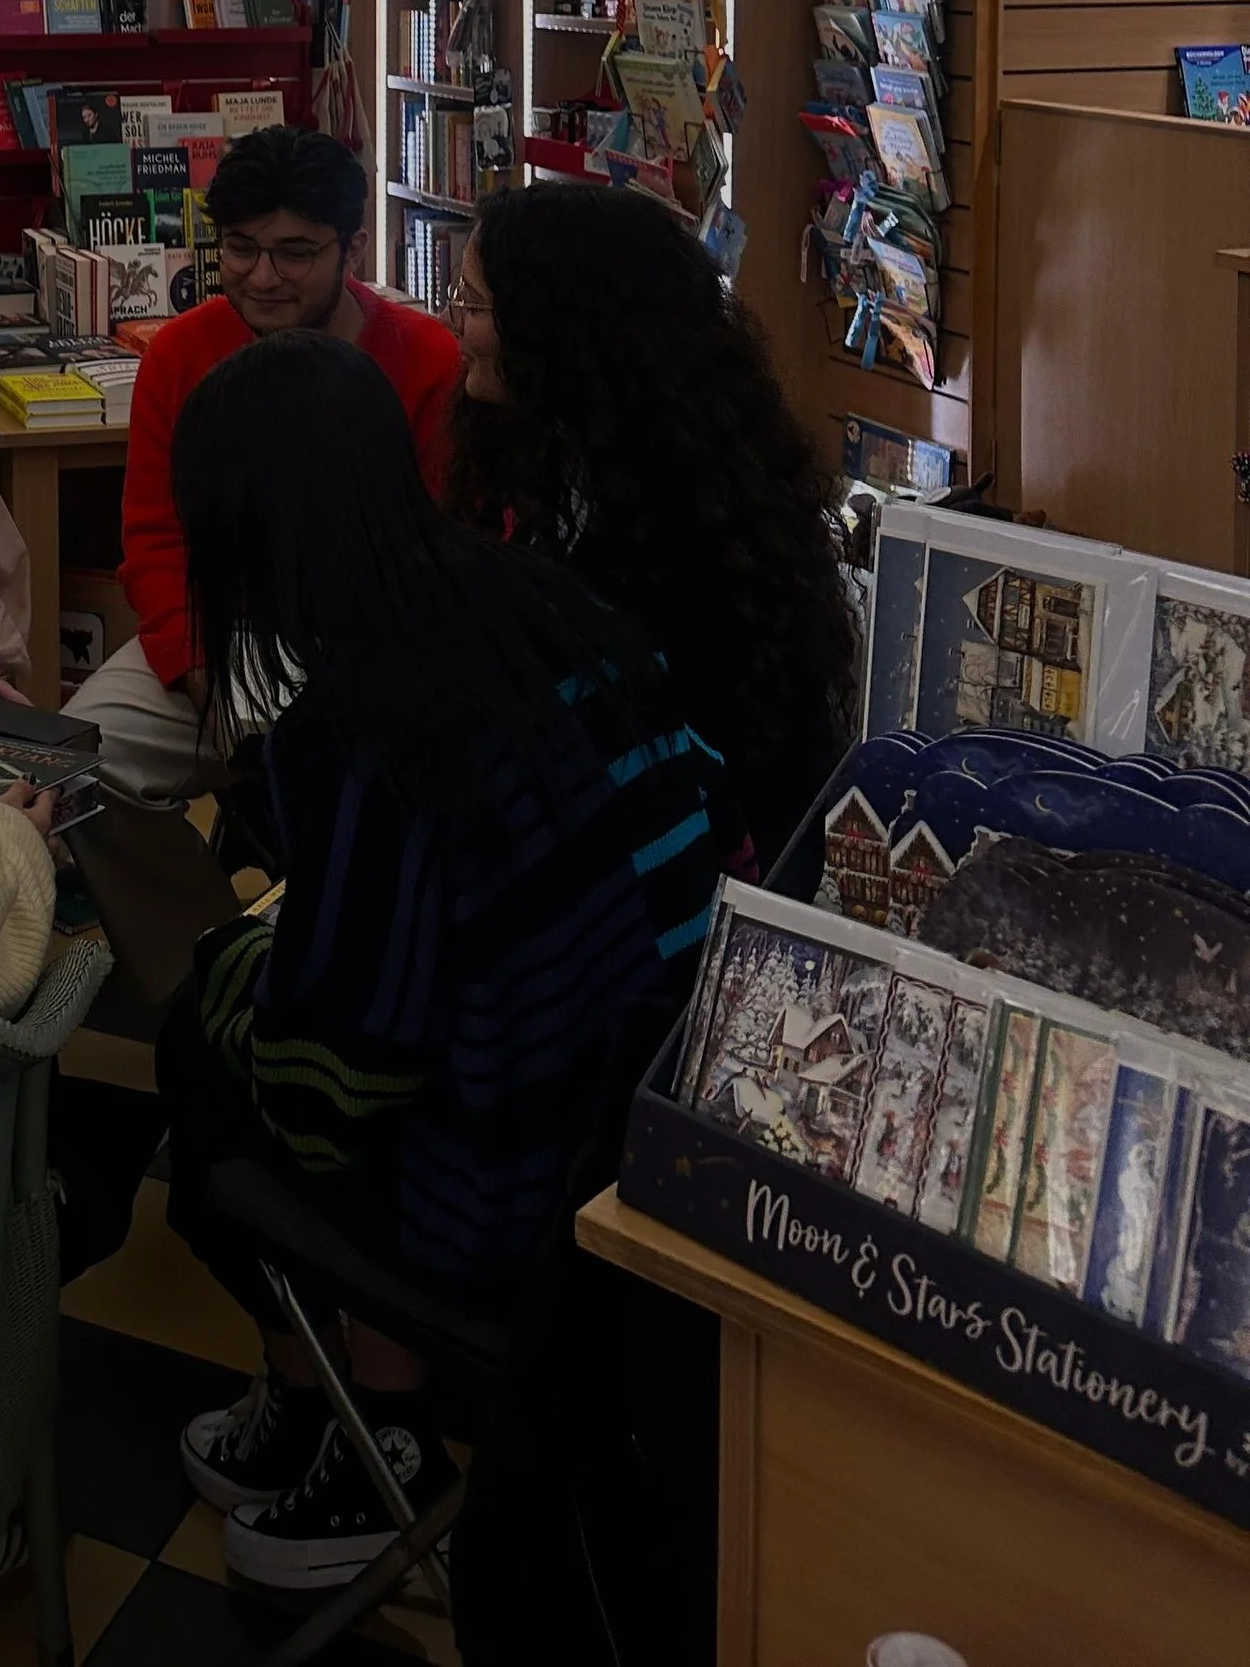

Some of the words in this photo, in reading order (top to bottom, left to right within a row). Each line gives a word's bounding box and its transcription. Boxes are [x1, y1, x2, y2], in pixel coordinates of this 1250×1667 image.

[119, 11, 136, 23] der
[225, 97, 249, 105] MAJA
[250, 96, 277, 104] LUNDE
[122, 111, 141, 123] WER
[126, 124, 145, 137] SOL
[142, 153, 180, 163] MICHEL
[137, 163, 187, 175] FRIEDMAN
[109, 305, 148, 316] PRACH
[746, 1179, 849, 1264] Moon
[851, 1234, 880, 1298] &
[887, 1252, 992, 1340] Stars
[995, 1306, 1215, 1468] Stationery
